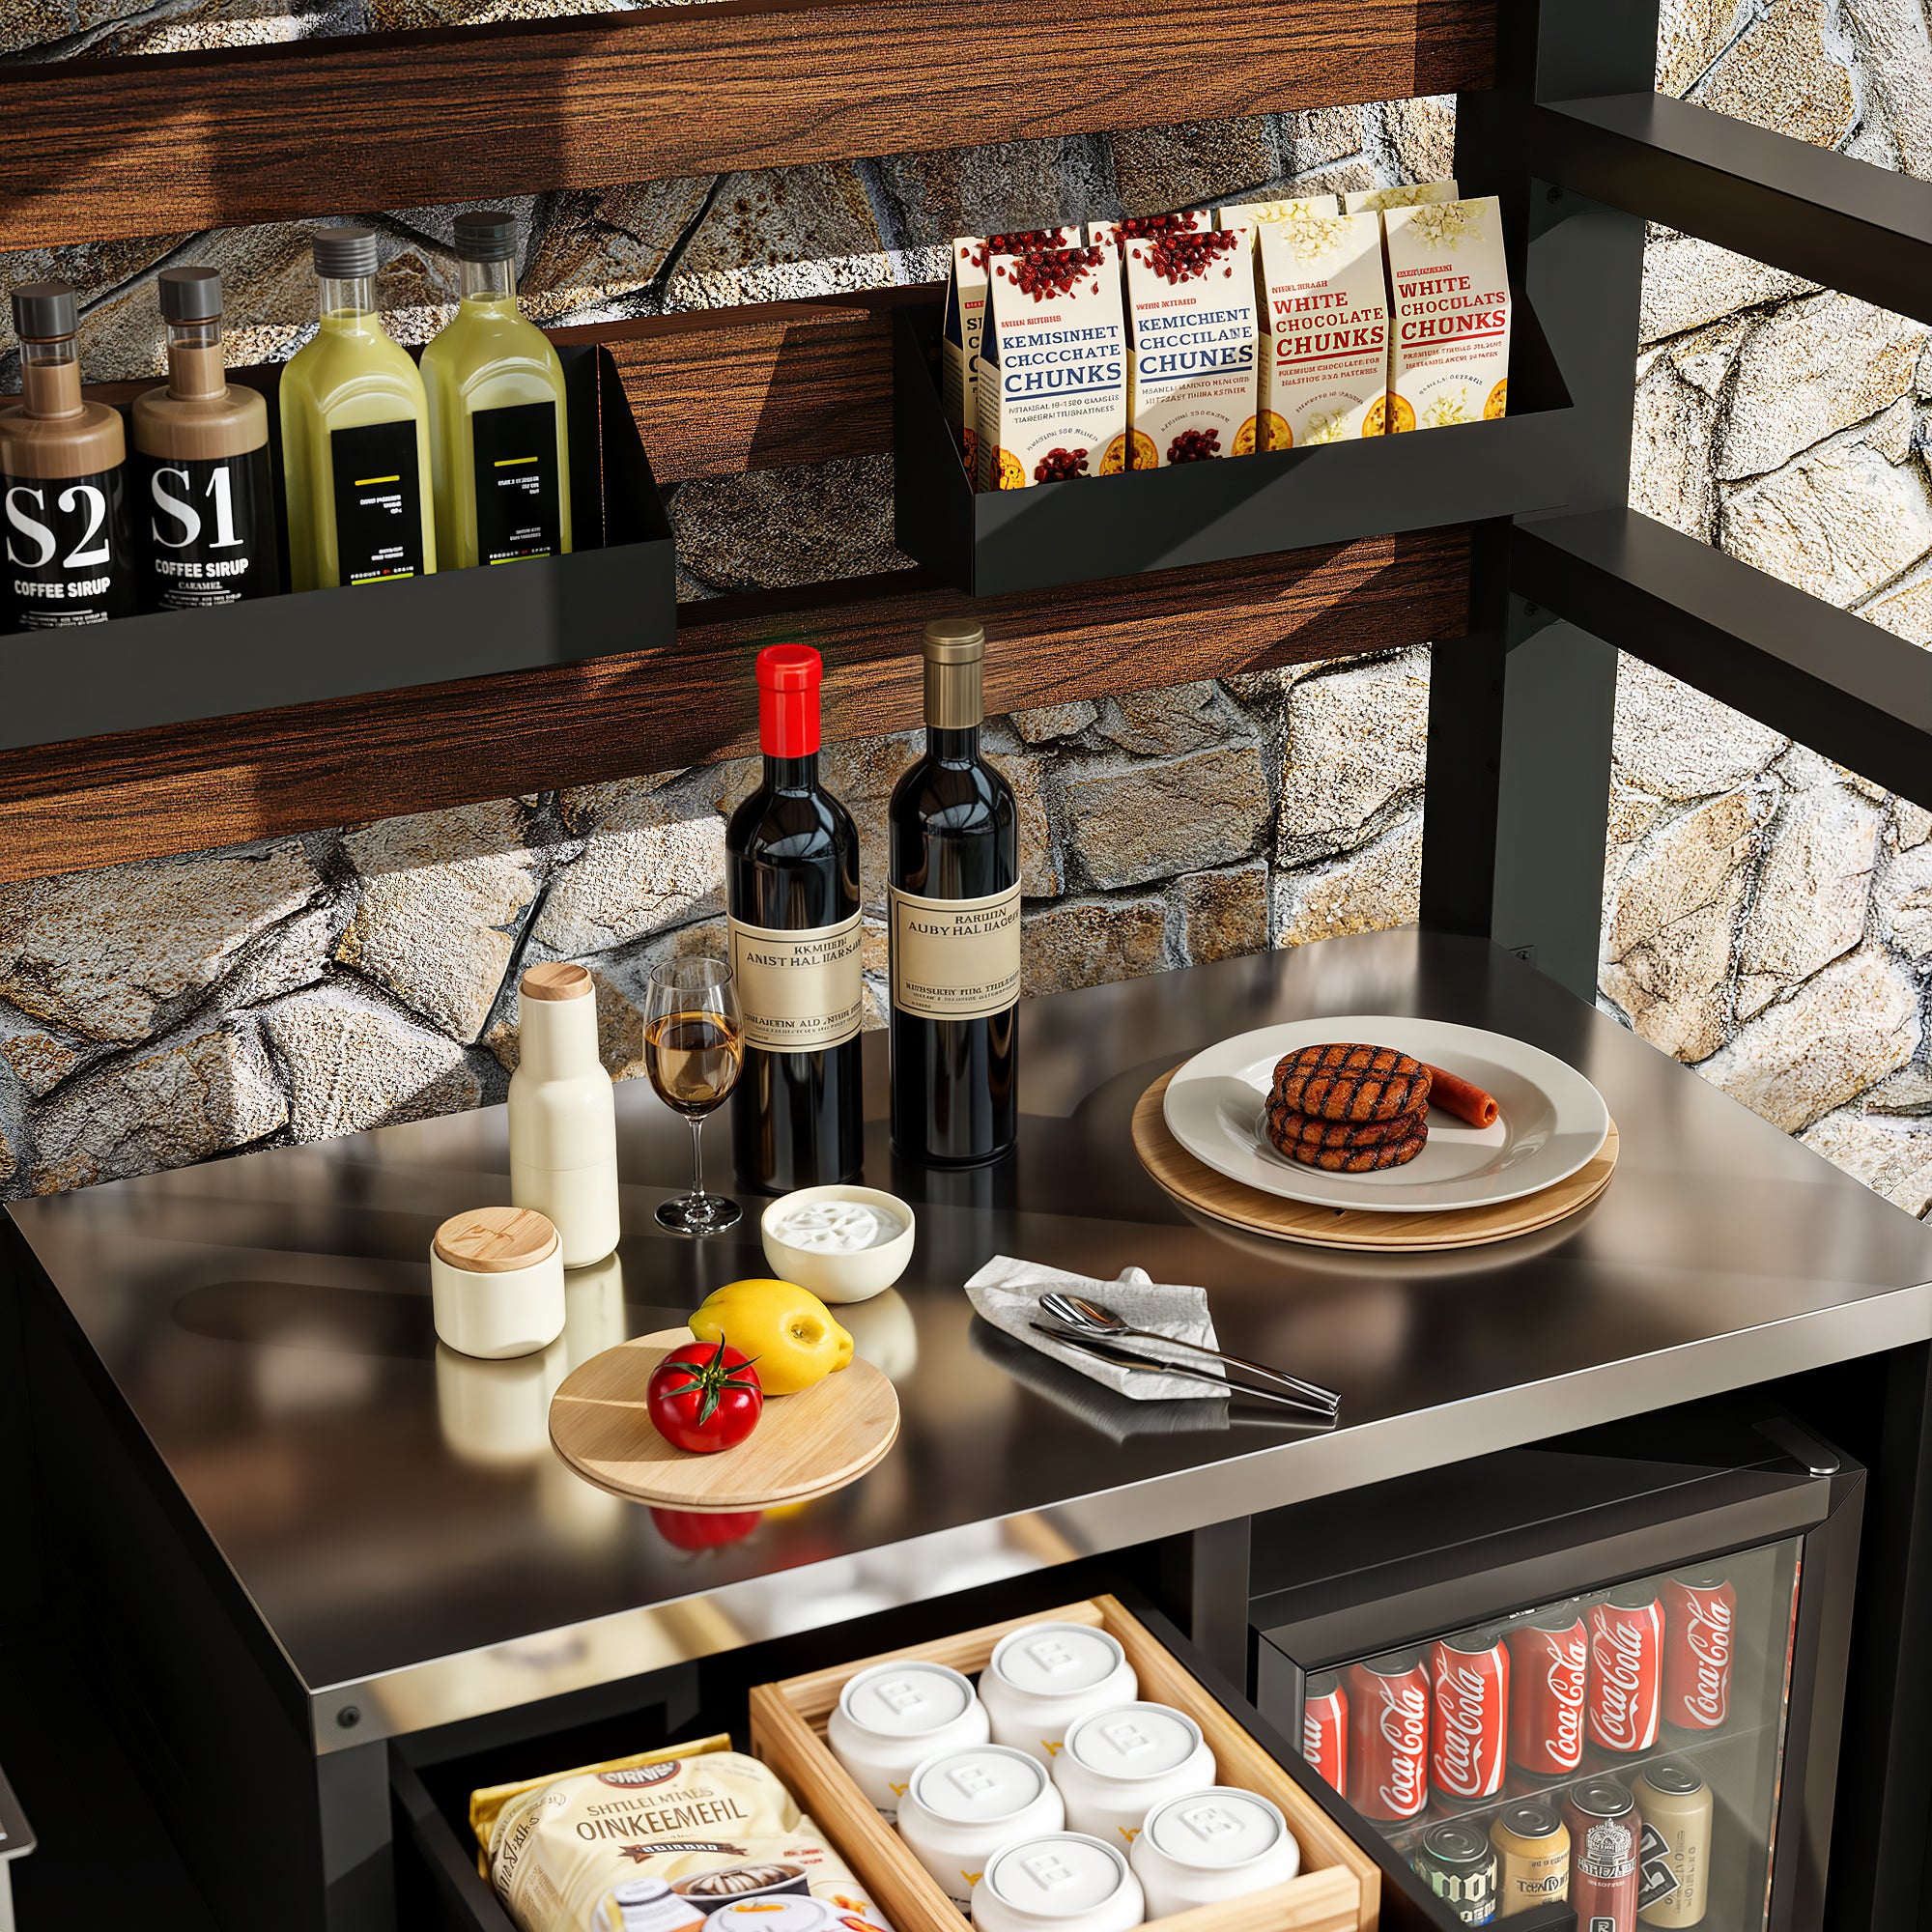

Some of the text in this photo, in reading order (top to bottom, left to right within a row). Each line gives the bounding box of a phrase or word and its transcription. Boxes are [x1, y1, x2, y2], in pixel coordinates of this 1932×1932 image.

[1398, 276, 1470, 298] WHITE
[1272, 292, 1348, 314] WHITE
[1275, 307, 1384, 333] CHOCOLATE
[1401, 309, 1506, 340] CHUNKS
[1276, 326, 1384, 357] CHUNKS
[1139, 344, 1253, 374] CHUNES
[1004, 362, 1122, 393] CHUNKS
[151, 467, 244, 549] S1
[5, 485, 111, 568] S2
[155, 557, 249, 578] COFFEE SIRUP
[14, 577, 111, 599] COFFEE SIRUP
